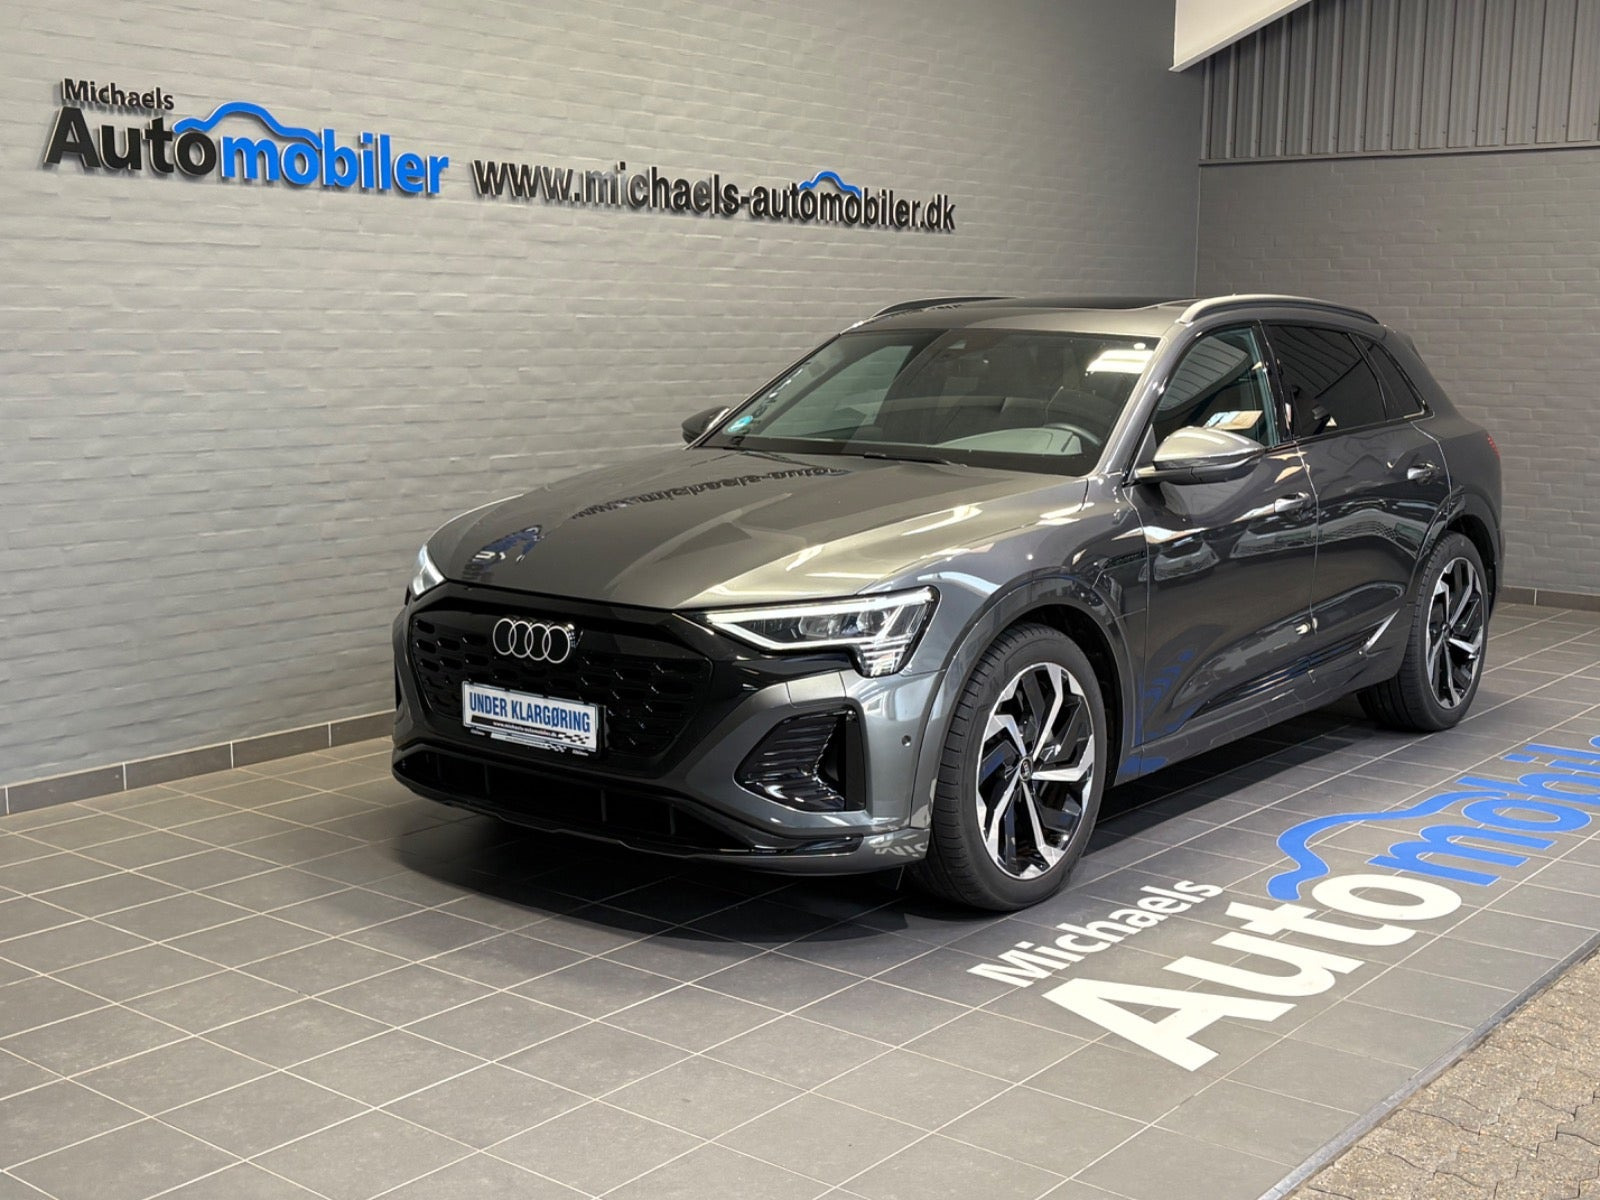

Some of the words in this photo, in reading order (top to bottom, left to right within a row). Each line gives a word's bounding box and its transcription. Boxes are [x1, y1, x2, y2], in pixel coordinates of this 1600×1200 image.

[61, 78, 175, 111] Michaels
[44, 104, 449, 195] Automobiler
[471, 159, 956, 232] www.michaels-automobiler.dk
[469, 692, 508, 717] UNDER
[511, 700, 591, 733] KLARGØRING
[966, 879, 1225, 988] Michaels
[1041, 735, 1600, 1072] Automobil
